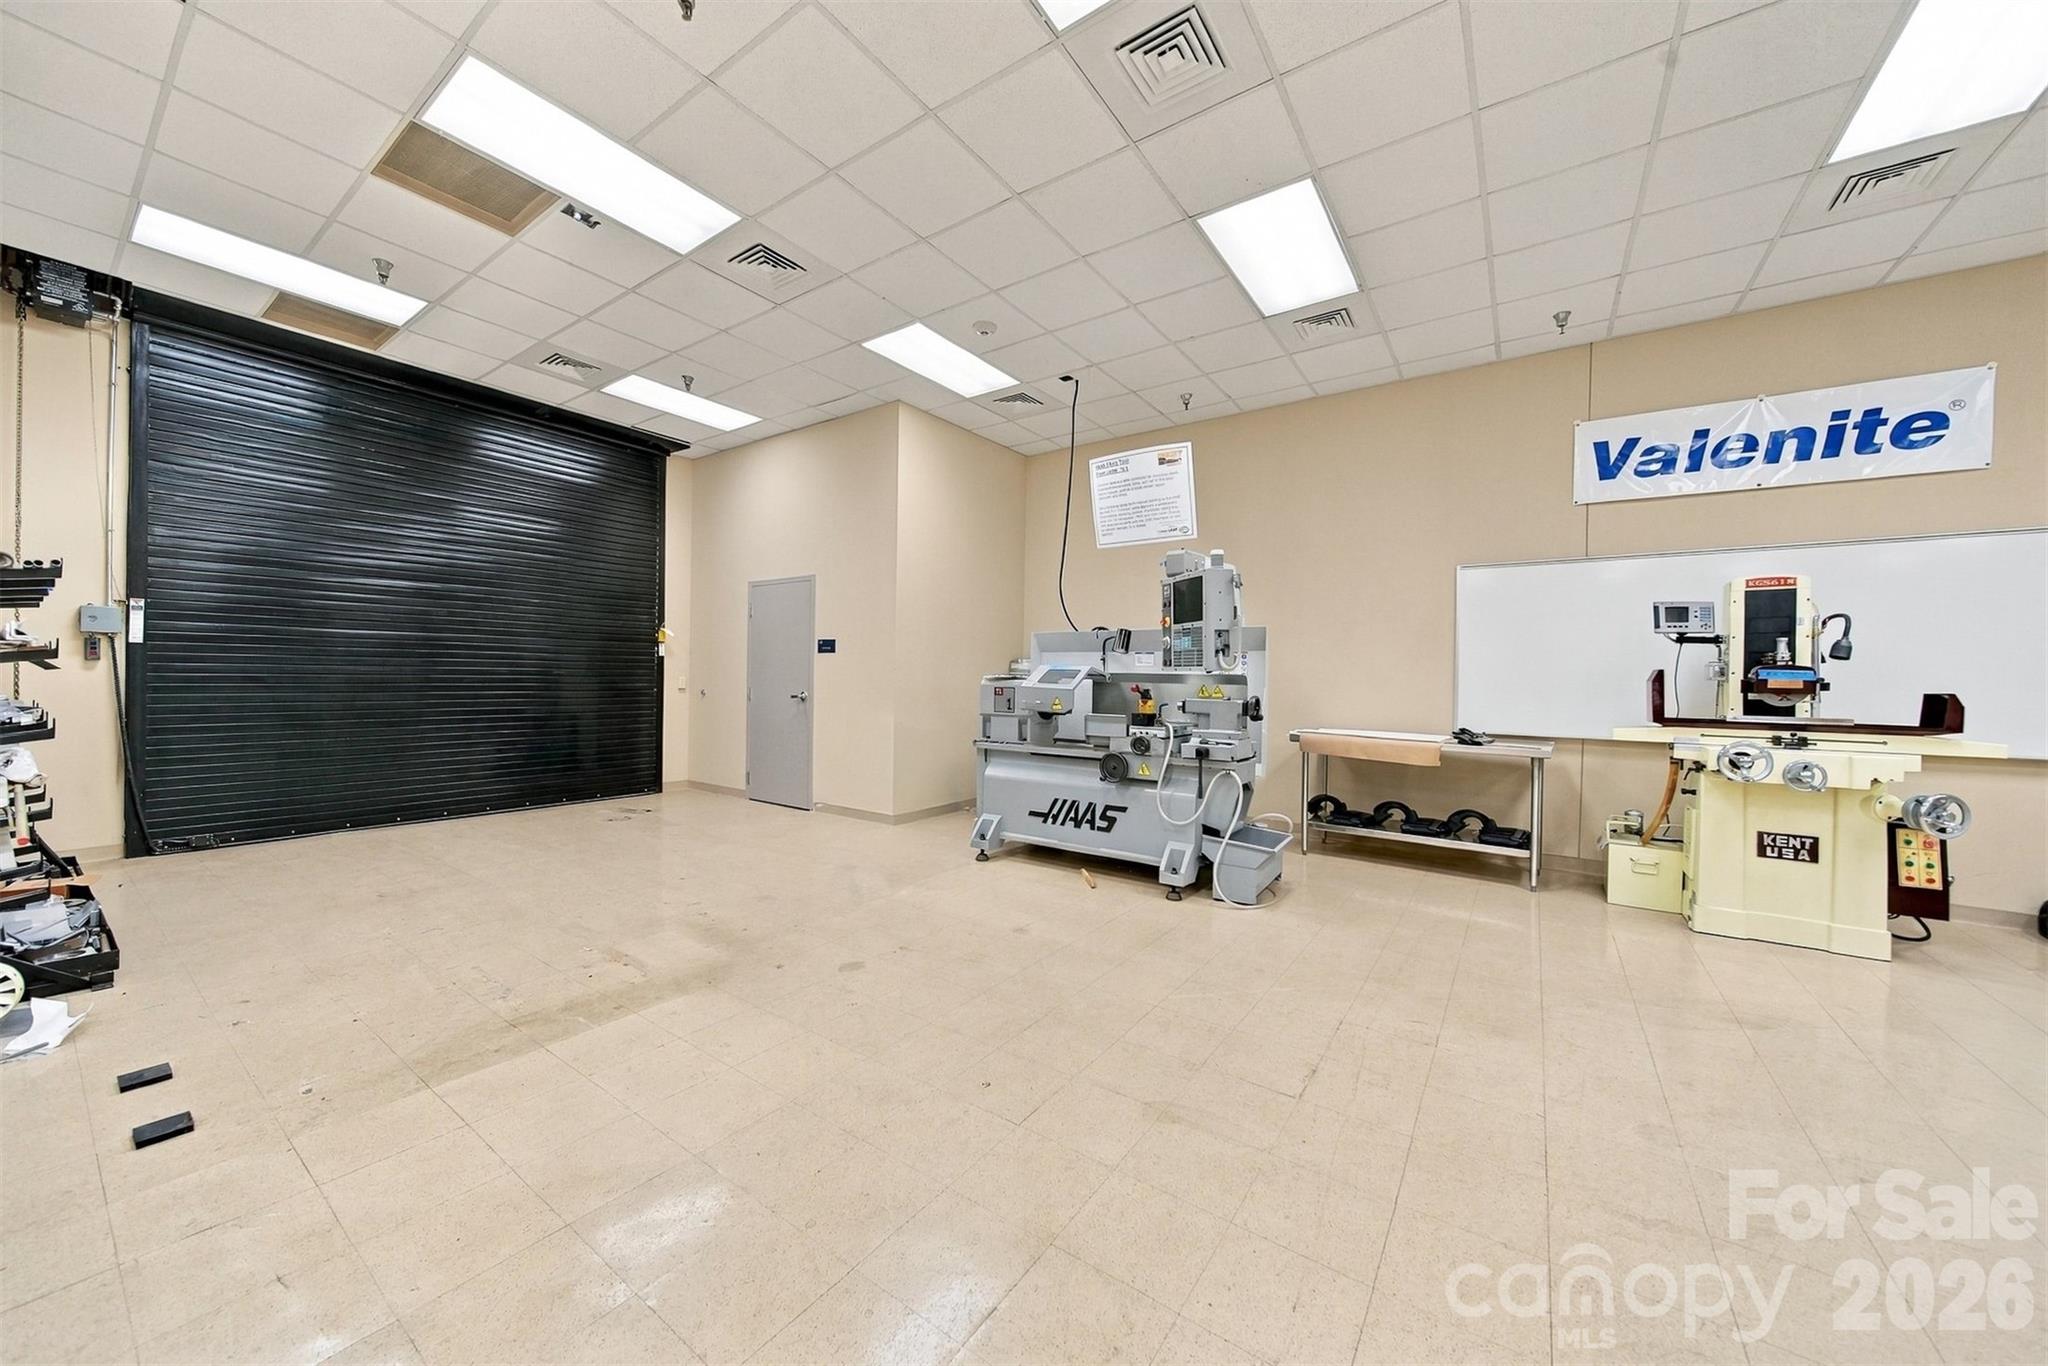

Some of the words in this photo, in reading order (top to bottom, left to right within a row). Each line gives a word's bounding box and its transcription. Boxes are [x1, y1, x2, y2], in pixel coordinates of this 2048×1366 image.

[1028, 798, 1128, 833] HAAS
[1763, 834, 1814, 849] KENT
[1766, 846, 1810, 861] USA
